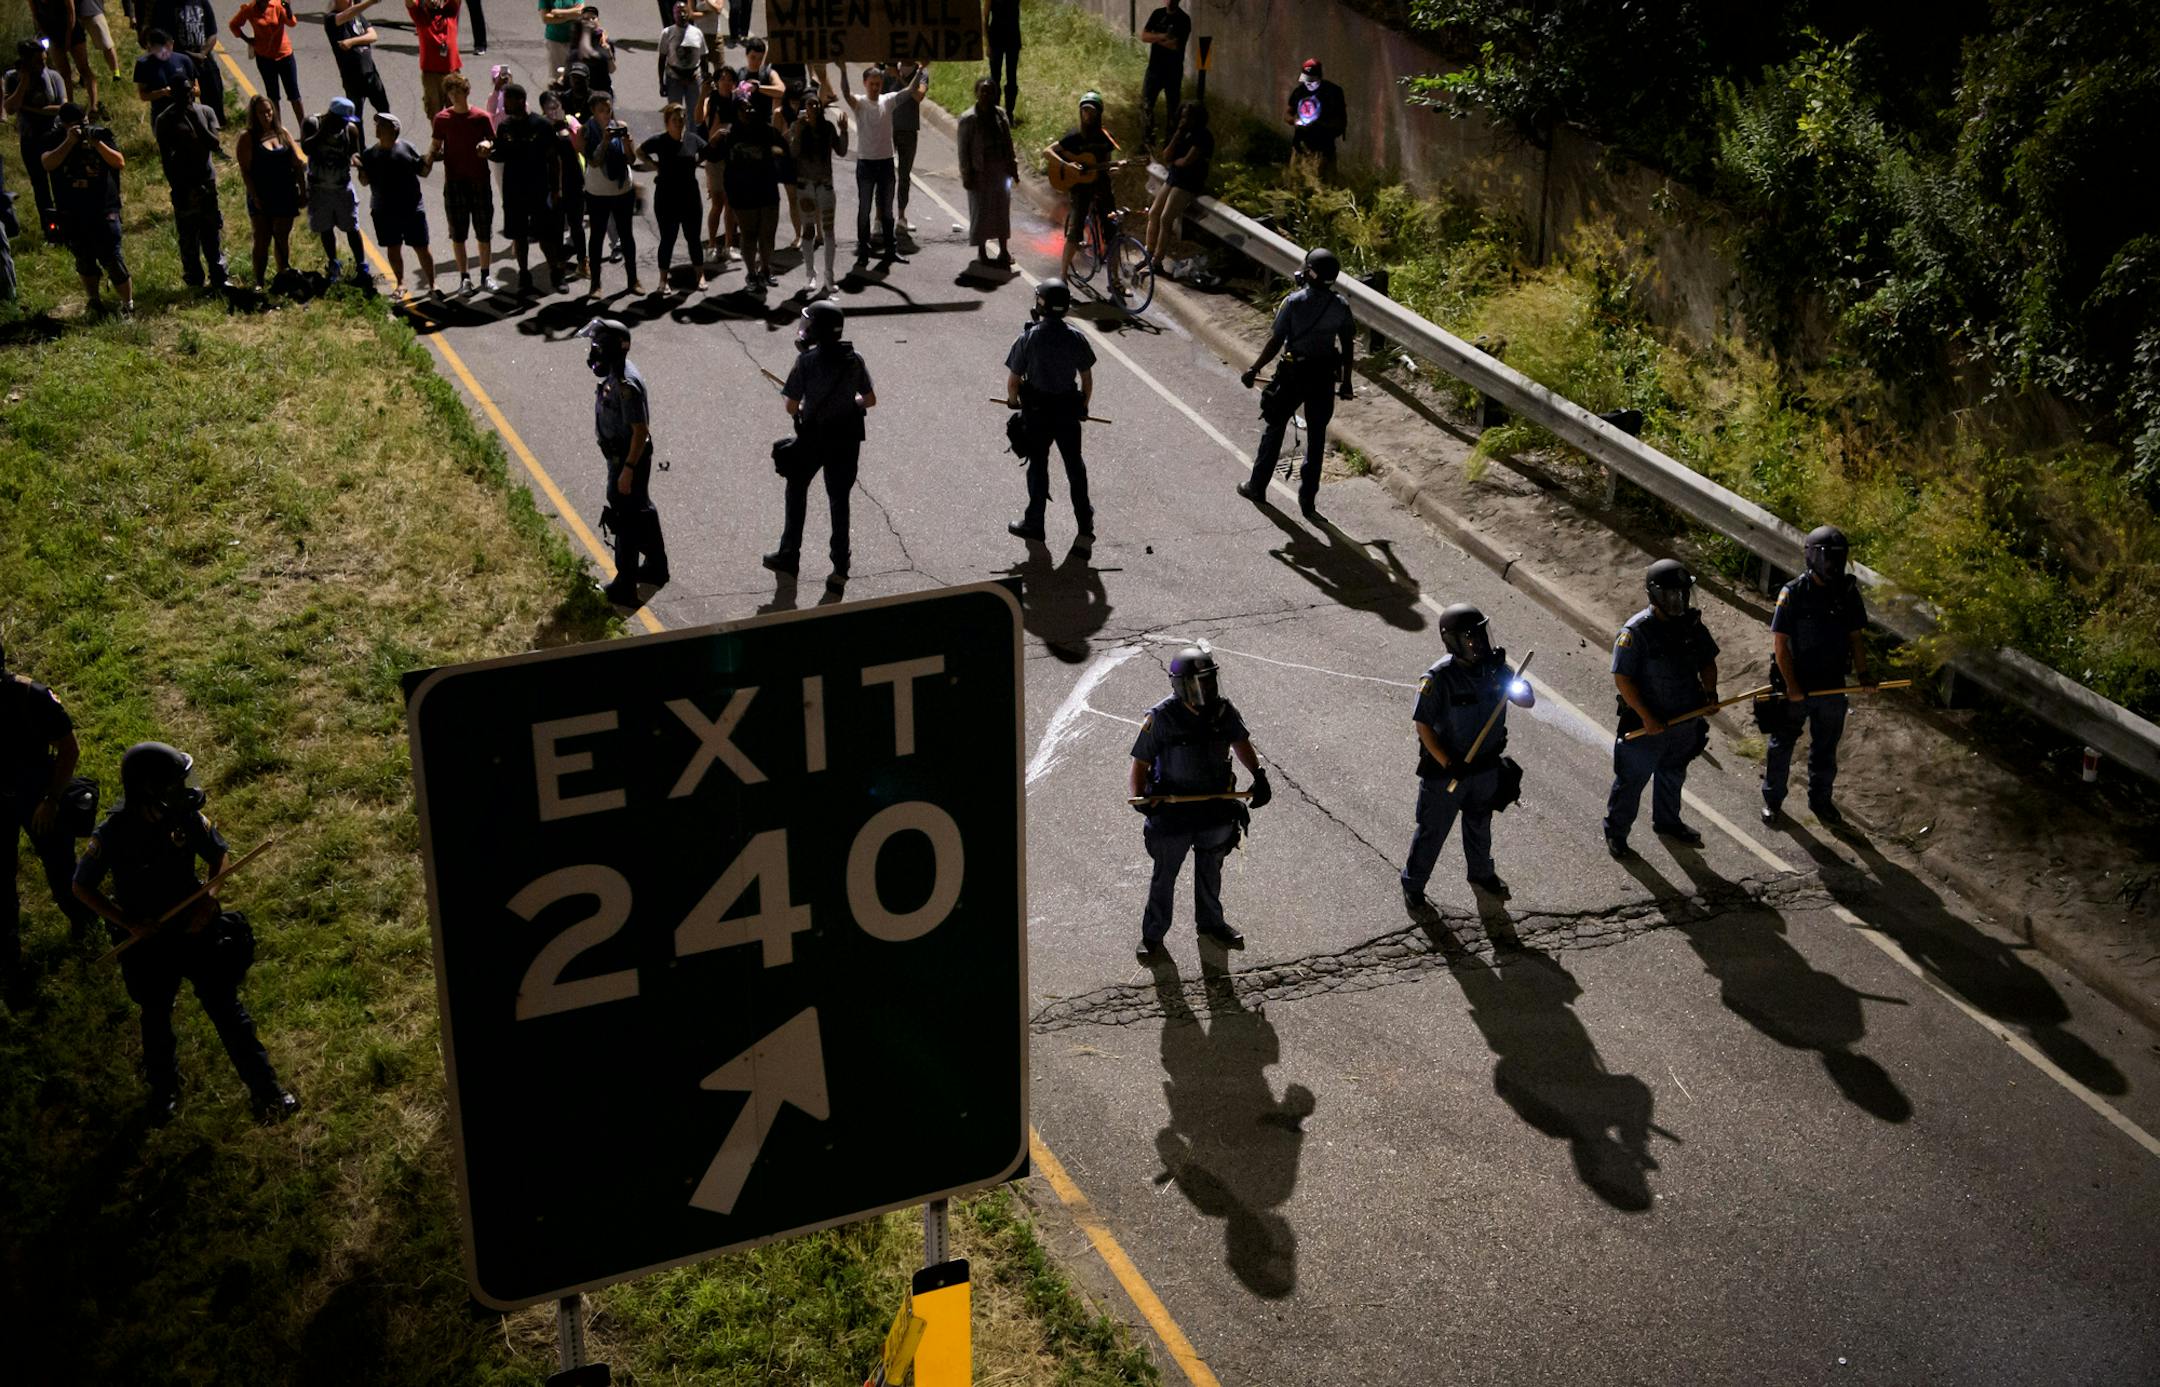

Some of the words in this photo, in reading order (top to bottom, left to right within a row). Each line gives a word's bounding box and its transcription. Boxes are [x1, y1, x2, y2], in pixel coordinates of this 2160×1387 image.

[770, 29, 847, 61] THIS
[890, 31, 981, 61] END?
[772, 0, 870, 27] WHEN
[884, 0, 961, 26] WILL
[531, 655, 945, 822] EXIT
[506, 800, 965, 1021] 240
